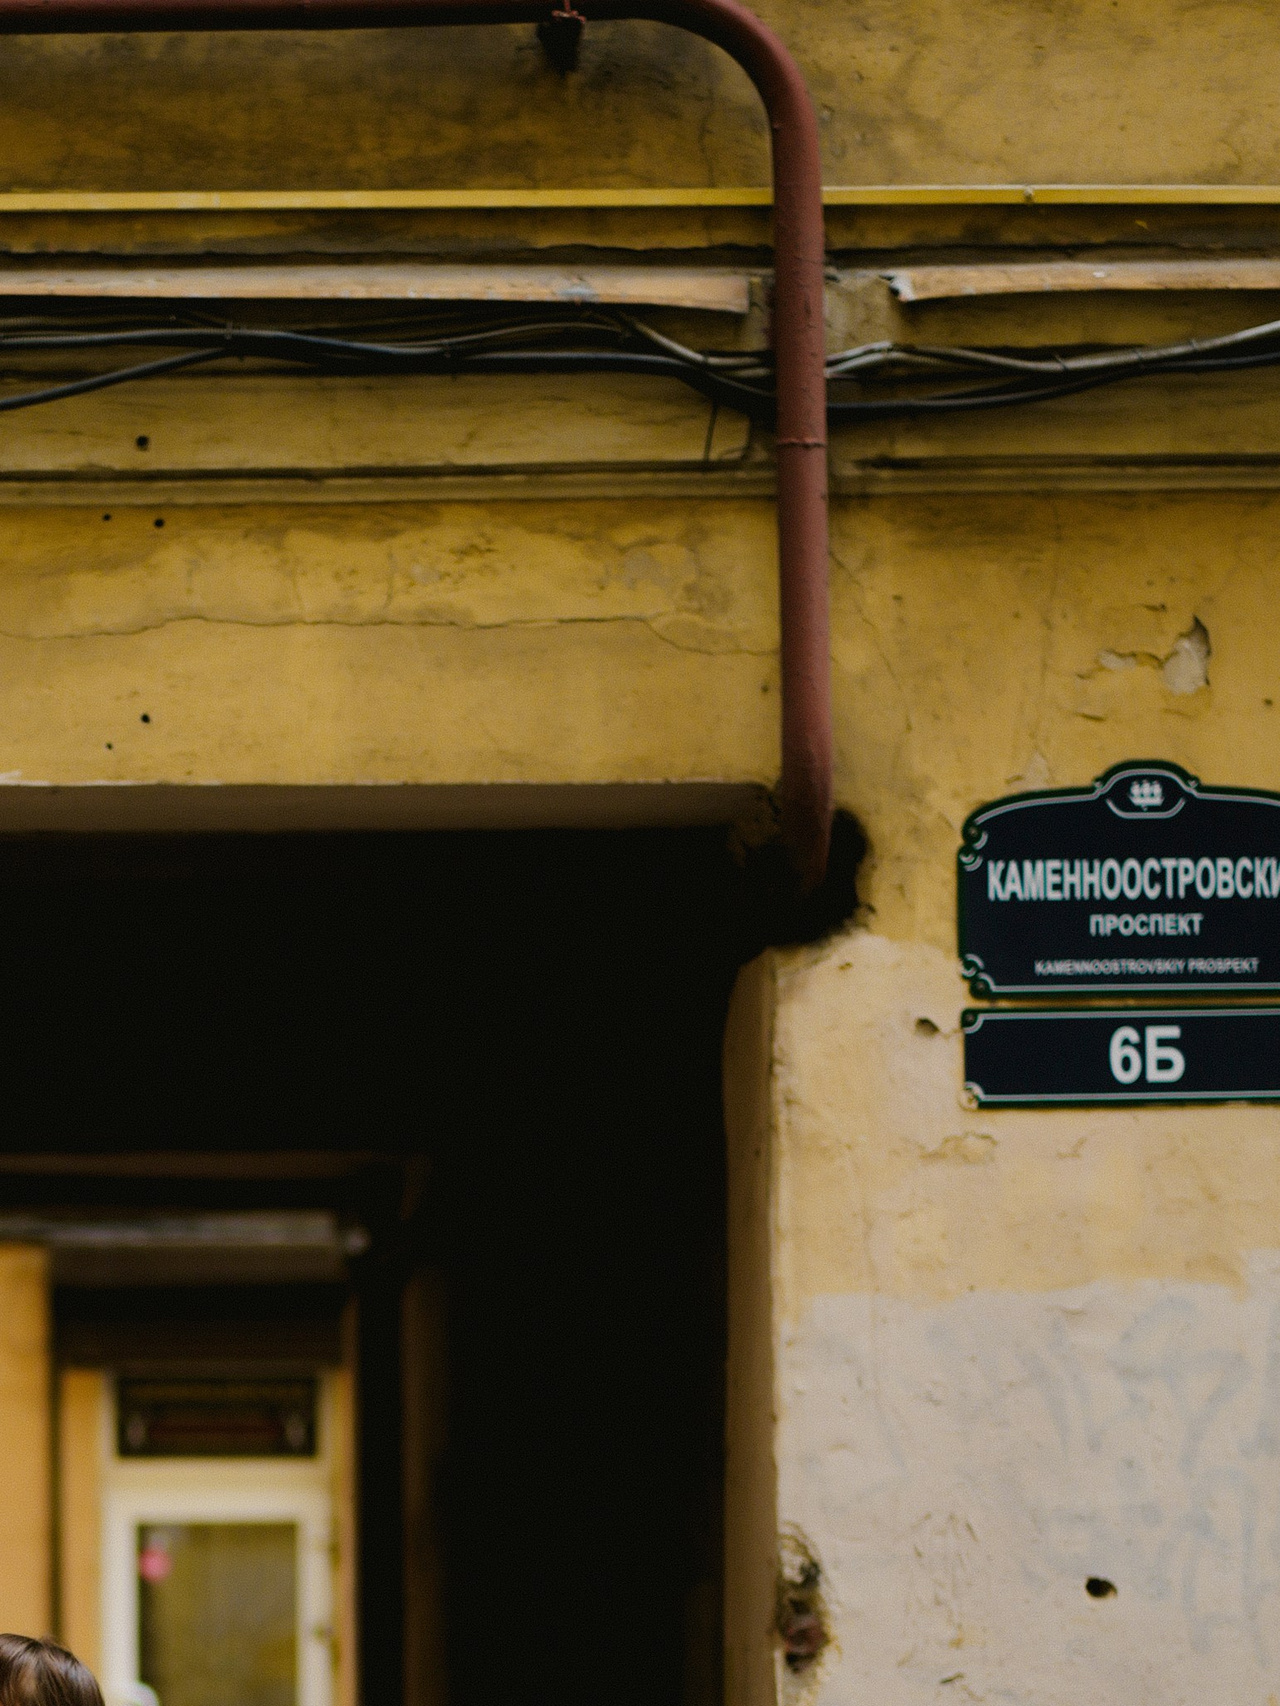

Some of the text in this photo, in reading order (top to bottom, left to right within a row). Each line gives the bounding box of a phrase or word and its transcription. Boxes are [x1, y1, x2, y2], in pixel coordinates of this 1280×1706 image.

[1089, 912, 1203, 936] ПРОСПЕКТ
[1034, 957, 1259, 976] KAMENNOOSTROVSKIY PROSPEKT
[1109, 1025, 1186, 1085] 6Б
